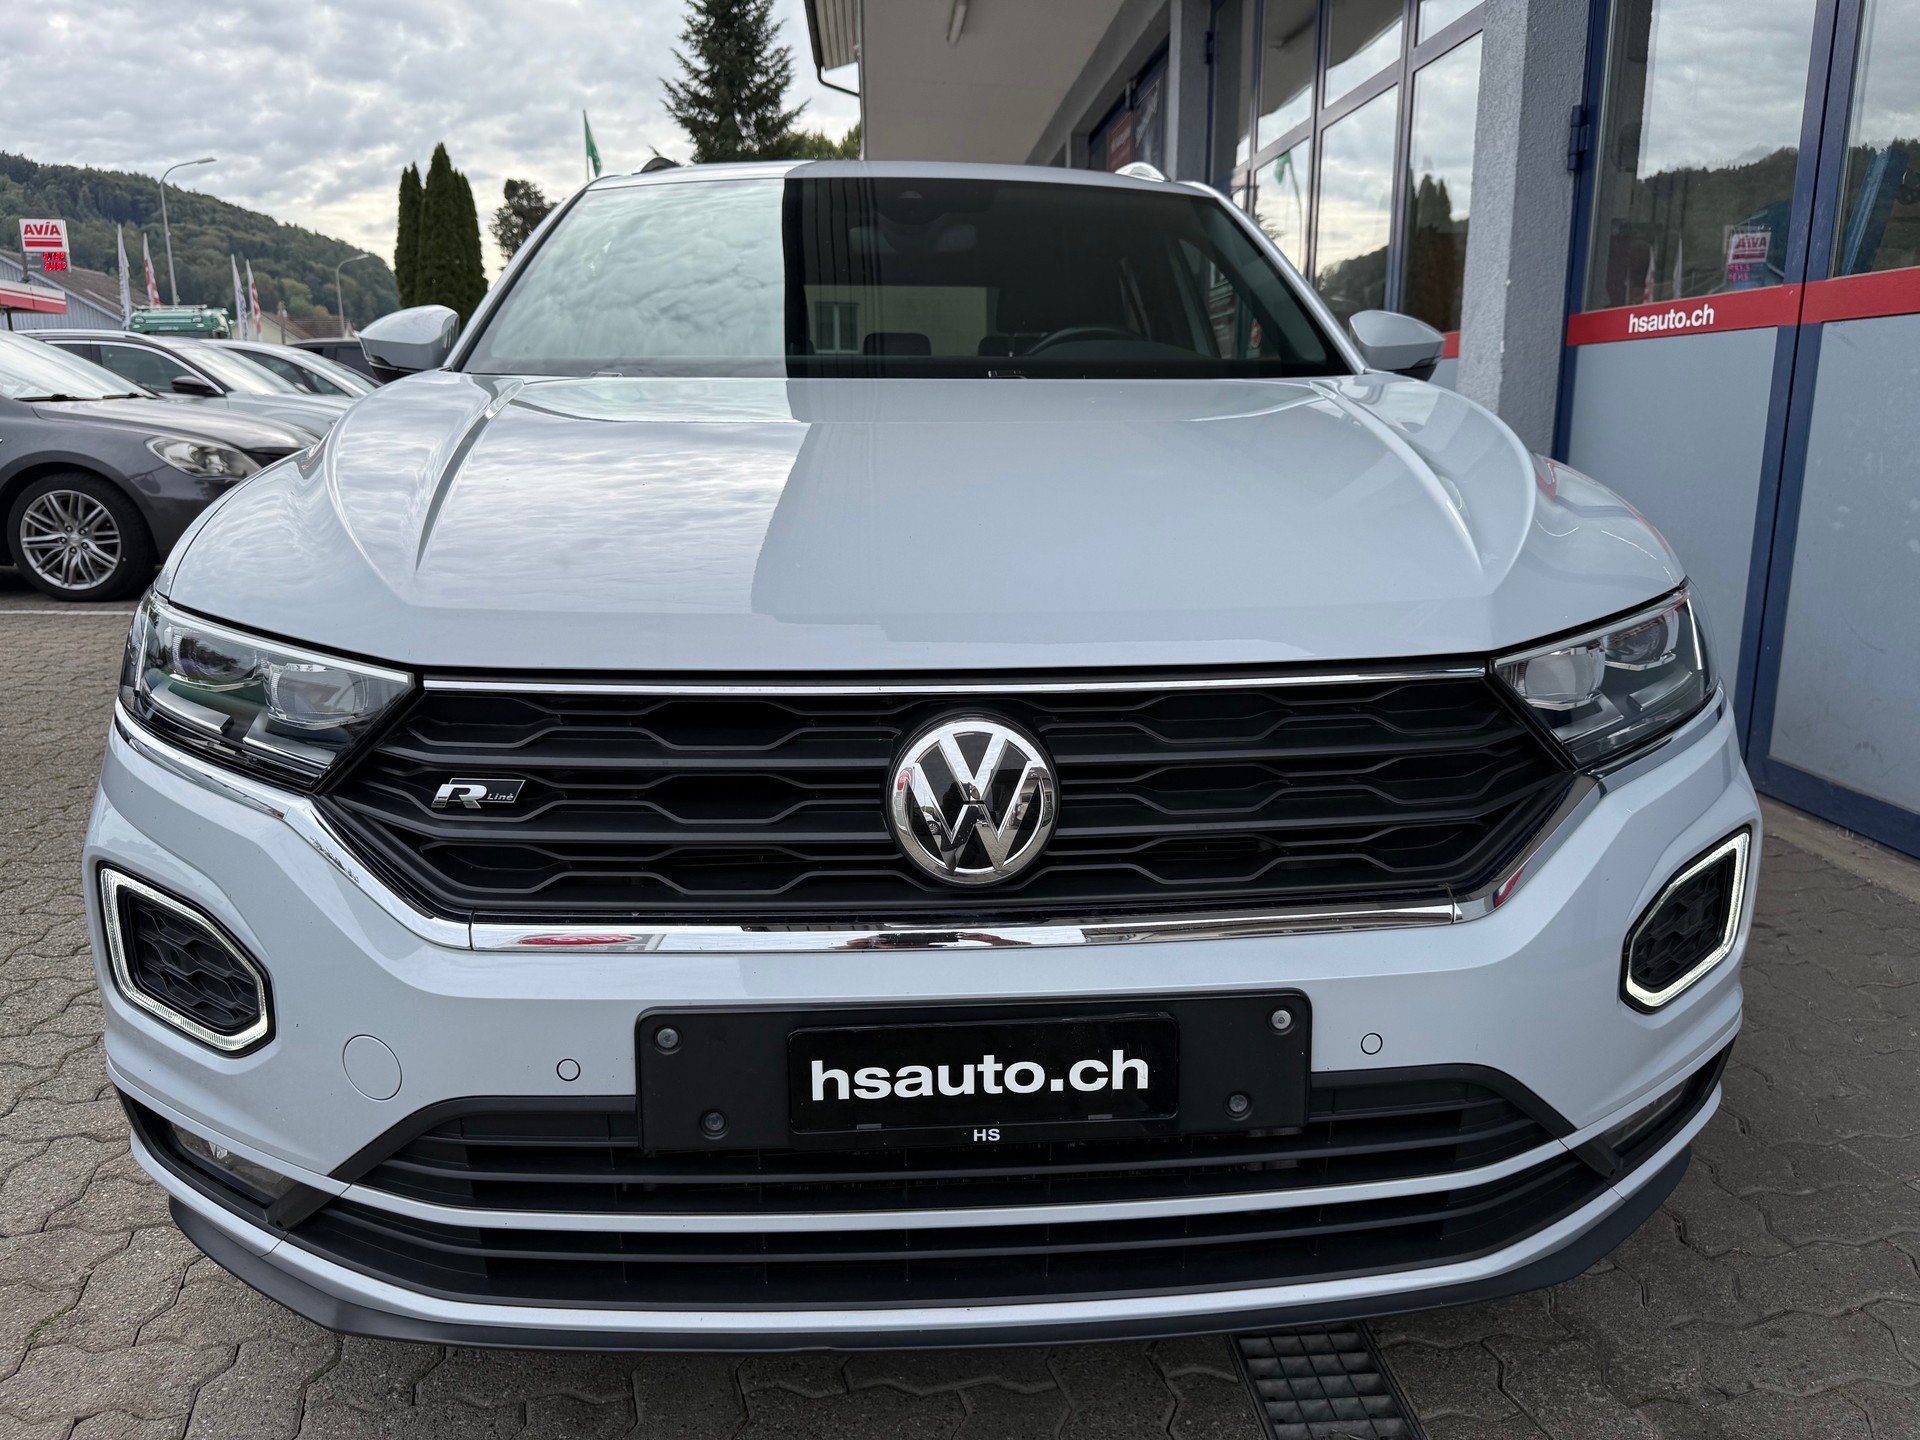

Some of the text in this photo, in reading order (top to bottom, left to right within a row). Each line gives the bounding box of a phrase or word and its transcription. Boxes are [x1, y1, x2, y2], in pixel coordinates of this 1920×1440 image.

[1628, 303, 1715, 334] hsauto.ch
[431, 783, 488, 809] R
[811, 1049, 1149, 1101] hsauto.ch
[973, 1128, 1001, 1142] HS
